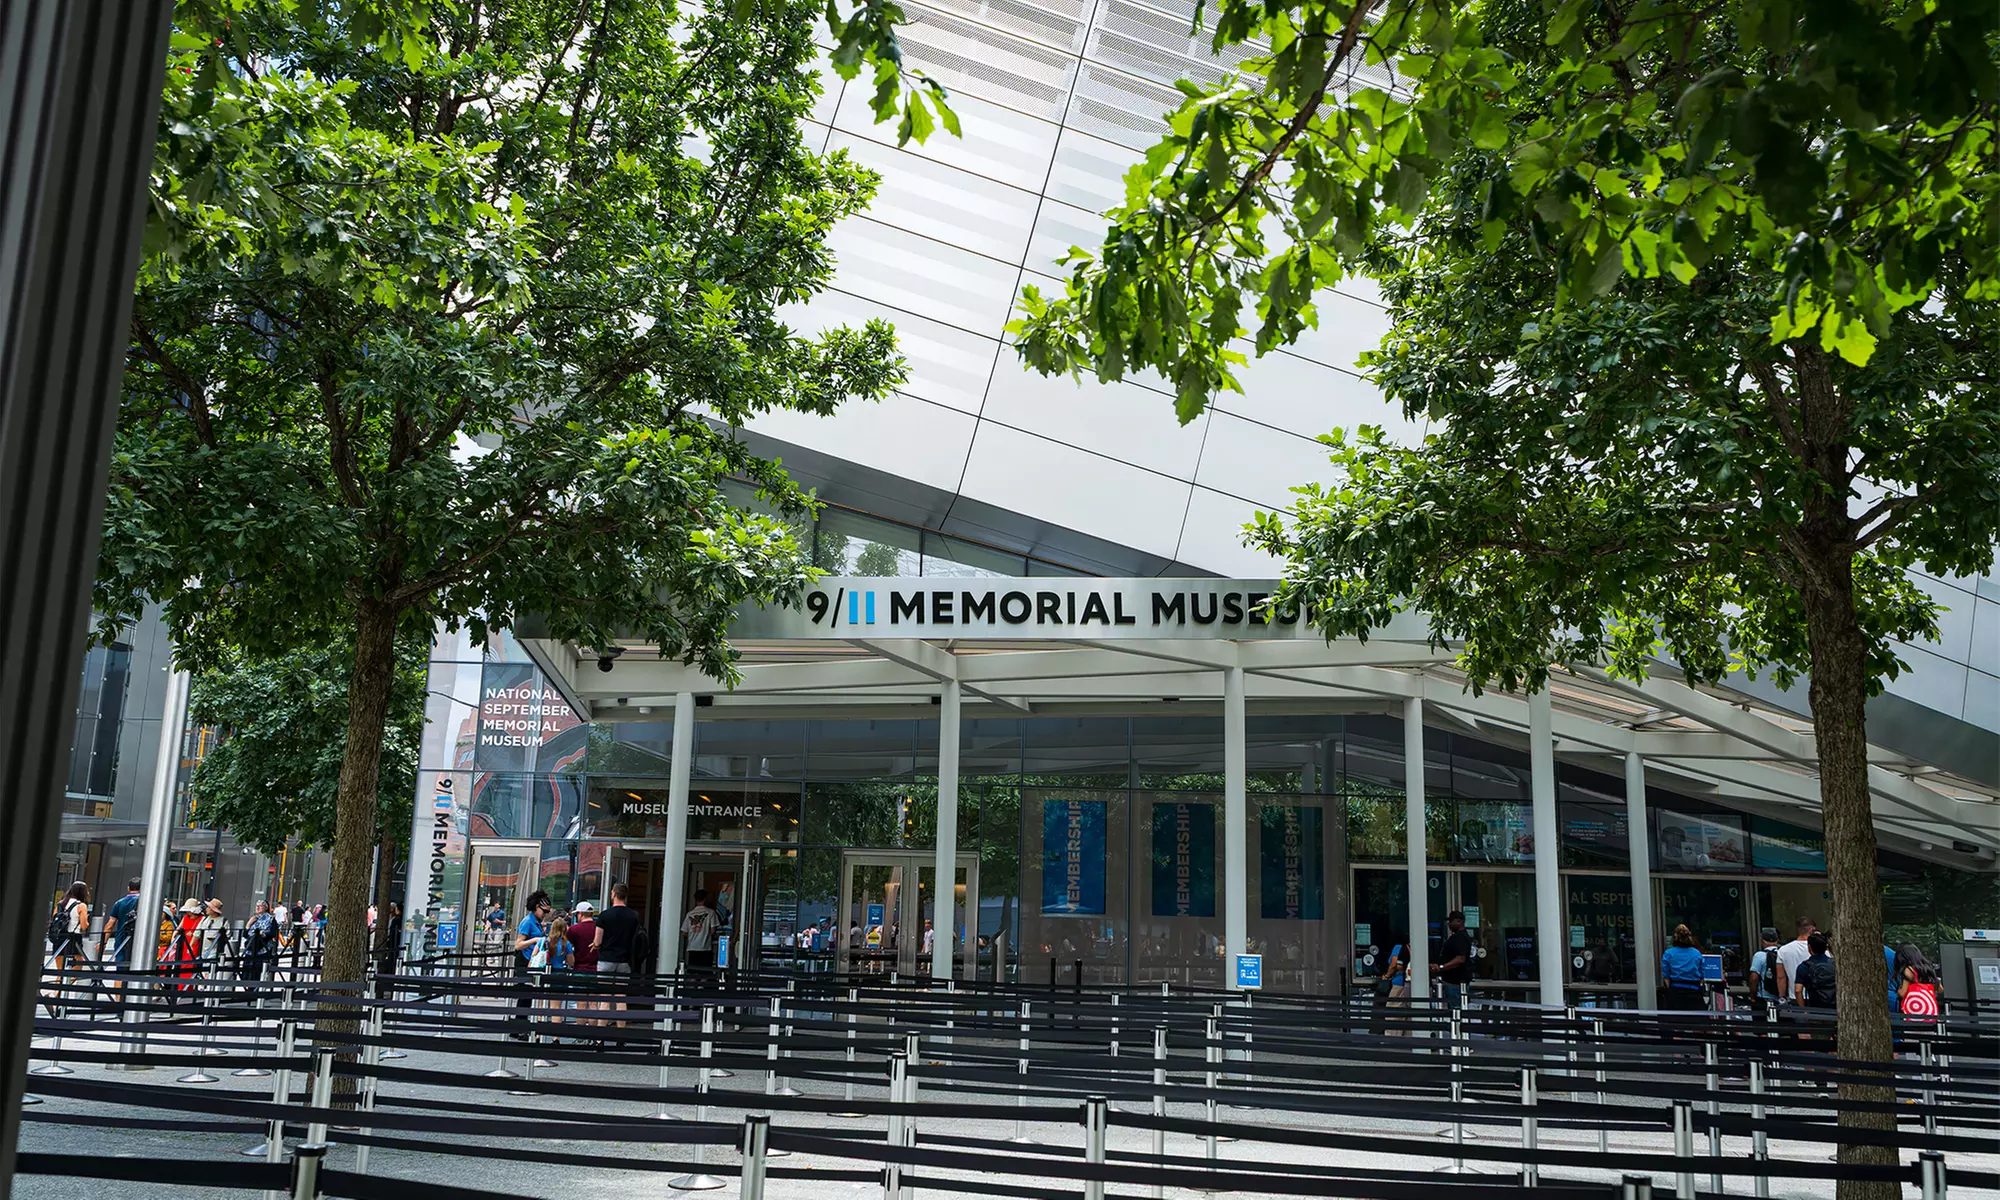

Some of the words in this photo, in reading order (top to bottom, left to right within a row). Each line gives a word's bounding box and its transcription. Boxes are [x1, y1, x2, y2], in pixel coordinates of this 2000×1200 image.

[806, 588, 875, 628] 9/11
[890, 591, 1136, 624] MEMORIAL
[1151, 592, 1318, 625] MUSEU
[486, 688, 560, 700] NATIONAL
[484, 703, 570, 716] SEPTEMBER
[483, 719, 560, 732] MEMORIAL
[481, 735, 543, 747] MUSEUM
[623, 803, 670, 815] MUSEU
[687, 804, 762, 817] ENTRANCE
[1751, 836, 1824, 851] MEMBERSHI
[1067, 801, 1081, 912] MEMBERSHIP
[1176, 804, 1190, 917] MEMBERSHIP
[1285, 806, 1299, 919] MEMBERSHIP
[426, 813, 450, 917] MEMORIAL
